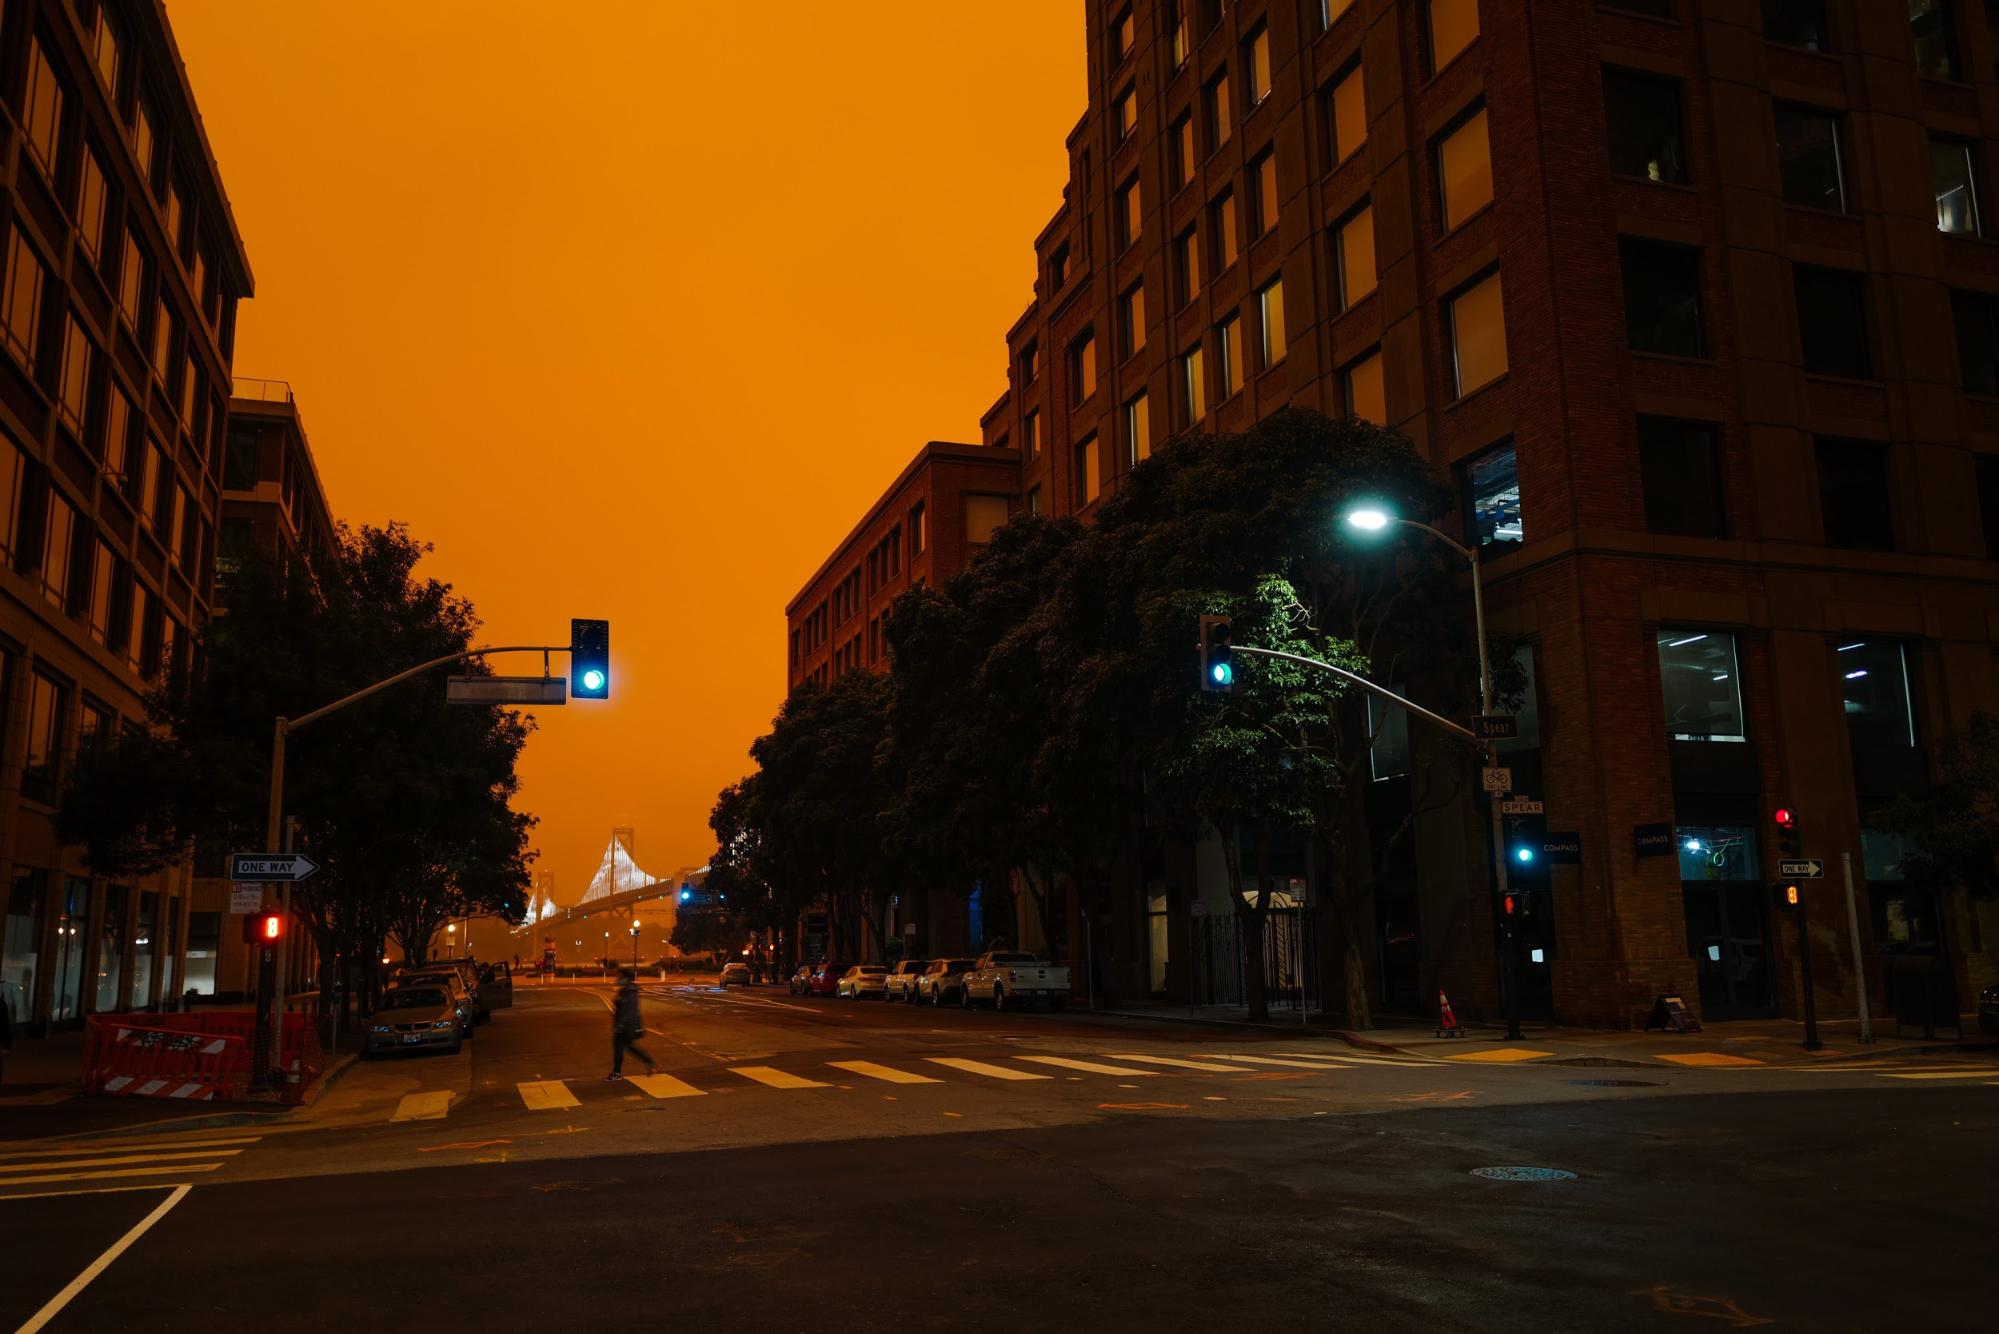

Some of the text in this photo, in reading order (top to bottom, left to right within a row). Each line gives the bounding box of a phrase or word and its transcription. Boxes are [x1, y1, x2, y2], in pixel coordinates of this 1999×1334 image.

[1504, 803, 1540, 812] SPEAR
[1637, 834, 1668, 846] COMPASS
[1543, 844, 1579, 852] COMPASS
[241, 862, 294, 872] ONE WAY
[1797, 865, 1809, 873] WAY
